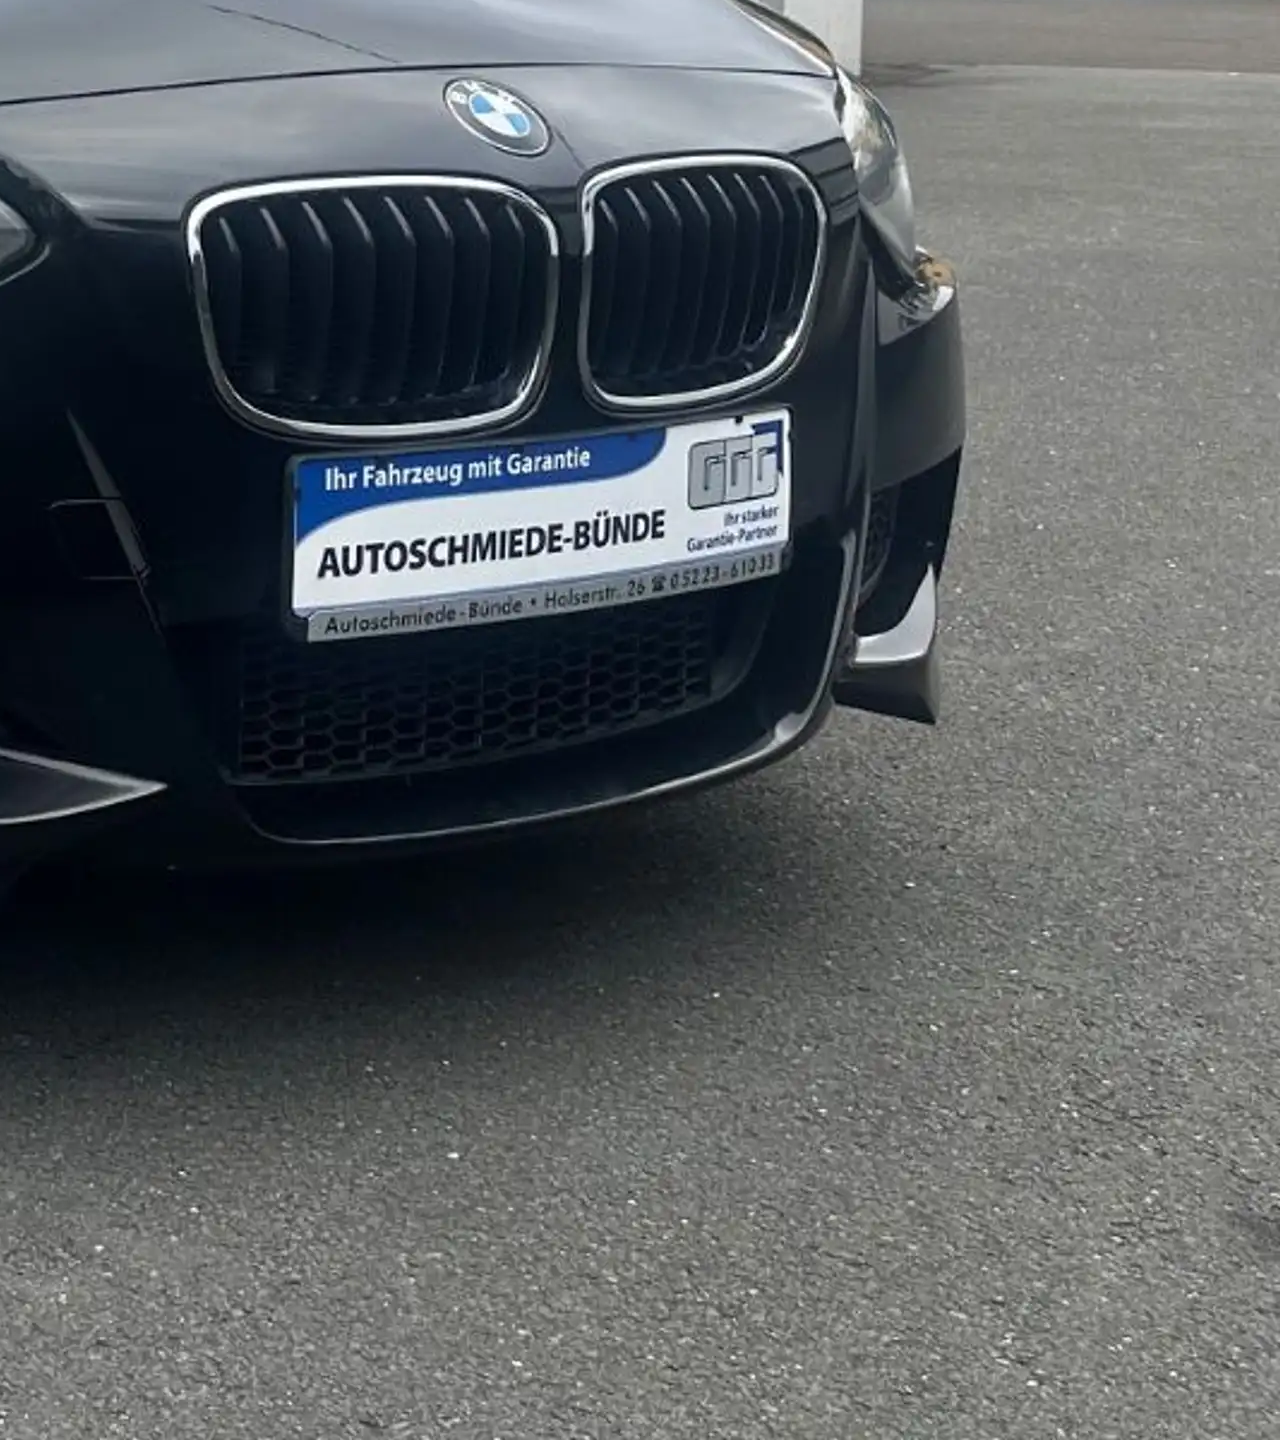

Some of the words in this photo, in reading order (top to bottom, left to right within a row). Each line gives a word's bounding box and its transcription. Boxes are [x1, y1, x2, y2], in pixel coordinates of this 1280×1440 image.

[324, 466, 357, 491] Ihr
[362, 461, 463, 488] Fahrzeug
[468, 454, 502, 479] mit
[506, 446, 591, 474] Garantie
[316, 508, 666, 579] AUTOSCHMIEDE-BÜNDE
[687, 524, 778, 552] Garantie-Partner
[627, 579, 646, 597] 26
